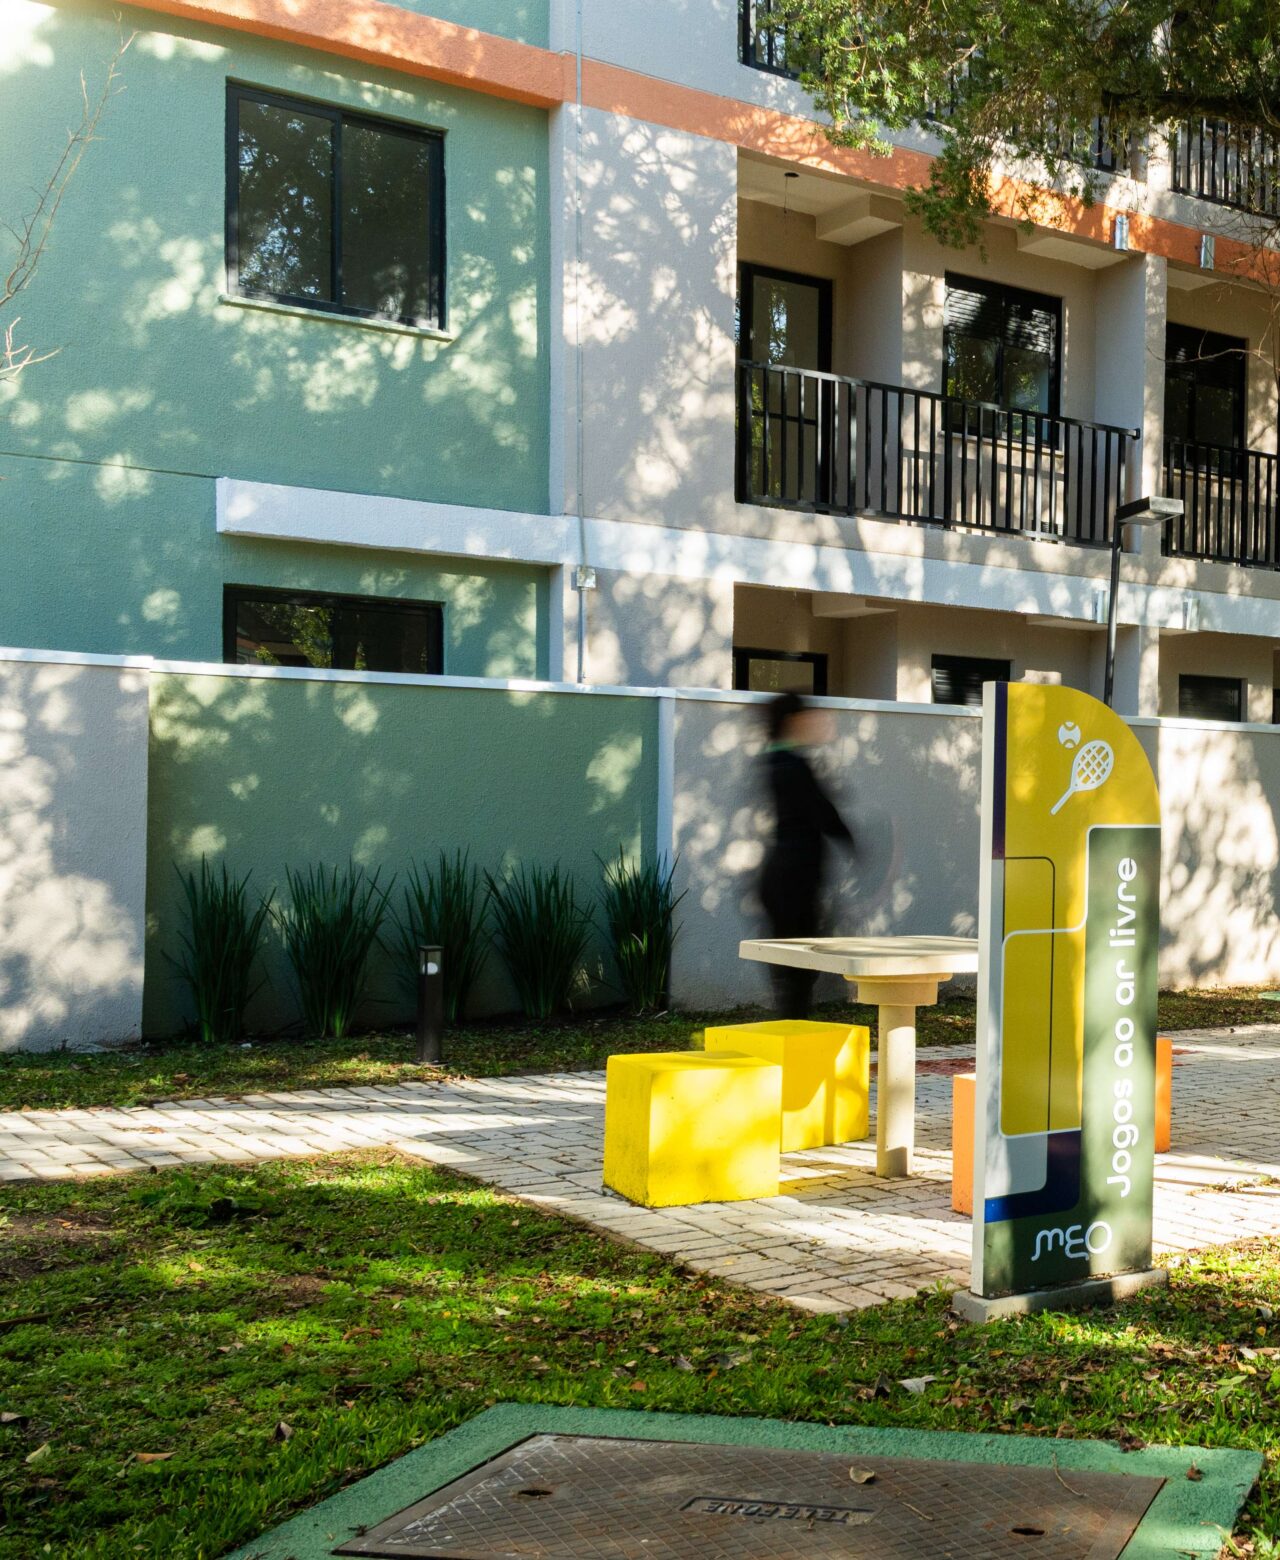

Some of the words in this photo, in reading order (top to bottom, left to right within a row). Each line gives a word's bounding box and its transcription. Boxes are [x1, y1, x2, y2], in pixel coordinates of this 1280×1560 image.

[1109, 857, 1138, 947] livre
[1115, 959, 1135, 1006] ar
[1113, 1017, 1135, 1068] ao
[1106, 1078, 1140, 1198] Jogos
[702, 1501, 850, 1524] TELEFONE
